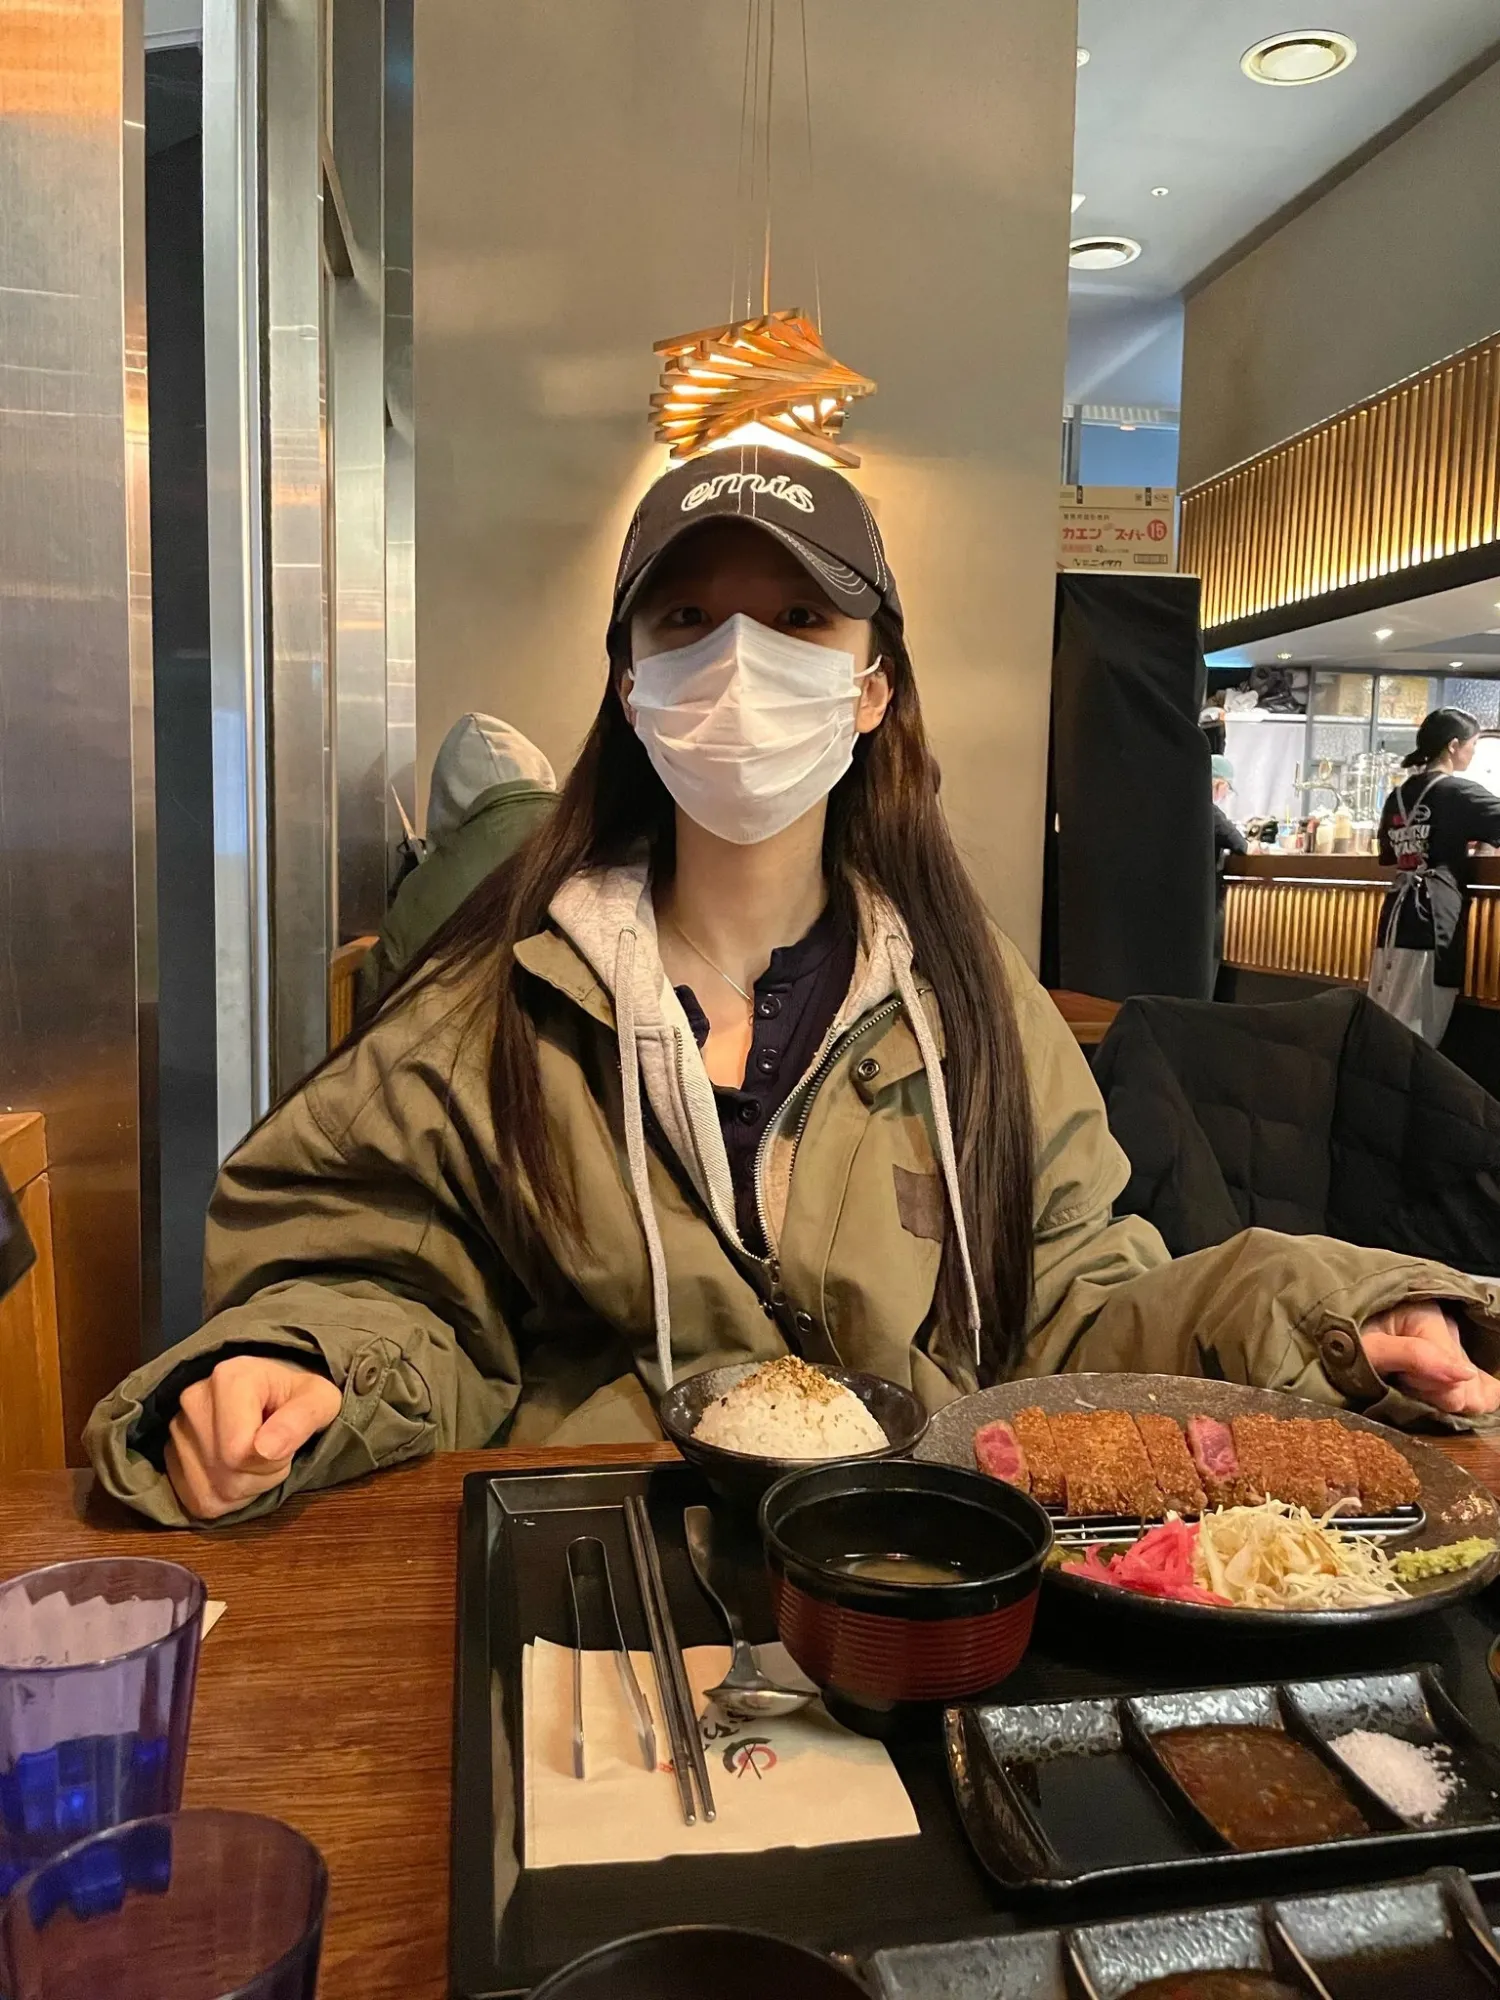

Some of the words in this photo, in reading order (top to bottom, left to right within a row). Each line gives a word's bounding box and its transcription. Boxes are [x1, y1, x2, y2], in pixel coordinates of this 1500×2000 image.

[1062, 527, 1102, 540] カエン
[1114, 528, 1146, 540] スーパー
